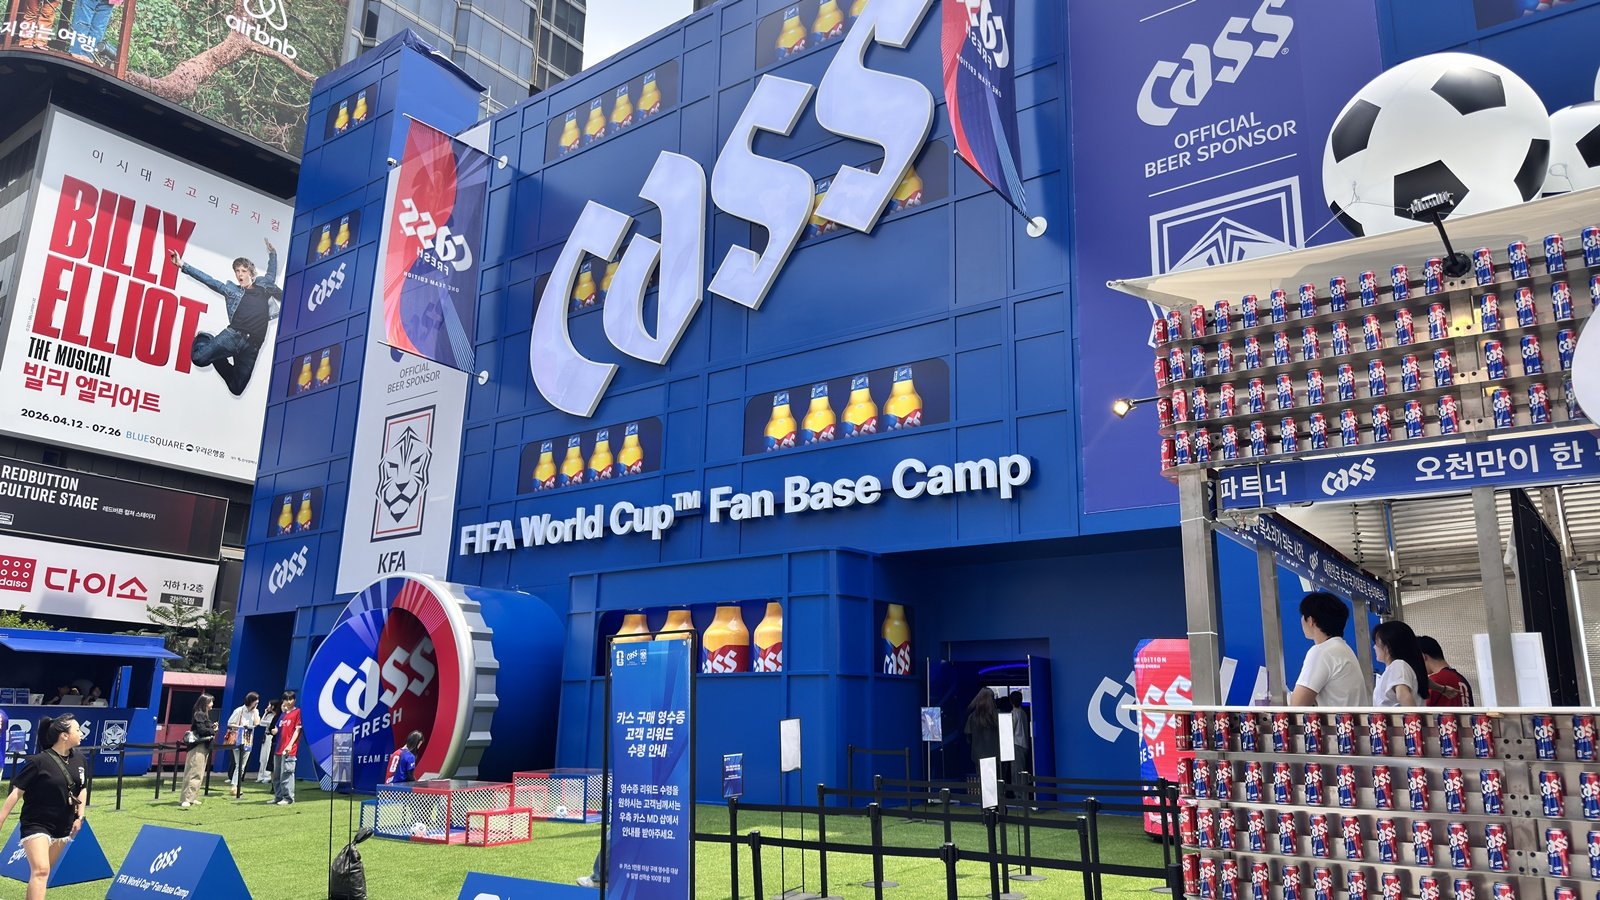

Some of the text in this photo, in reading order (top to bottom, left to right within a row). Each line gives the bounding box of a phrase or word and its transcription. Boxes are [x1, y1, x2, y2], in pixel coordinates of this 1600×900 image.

[0, 20, 99, 52] 지 않는 여행.
[226, 13, 297, 60] airbnb
[1174, 111, 1262, 149] OFFICIAL
[1145, 120, 1298, 178] BEER SPONSOR
[49, 174, 197, 290] BILLY
[31, 253, 208, 375] ELLIOT
[27, 337, 112, 378] THE MUSICAL
[399, 362, 430, 378] OFFICIAL
[23, 361, 161, 413] 빌리 엘리어트
[387, 370, 440, 393] BEER SPONSOR
[21, 408, 83, 429] 2026.04.12
[92, 423, 121, 438] 07.26
[126, 430, 185, 450] BLUESQUARE
[1415, 445, 1539, 481] 오천만이
[1550, 440, 1583, 470] 한
[1, 465, 79, 491] REDBUTTON
[1220, 471, 1287, 499] 파트너
[0, 481, 99, 510] CULTURE STAGE
[459, 519, 516, 555] FIFA
[520, 504, 604, 548] World
[710, 486, 774, 523] Fan
[784, 475, 881, 514] Base
[892, 453, 1031, 499] Camp
[377, 550, 406, 574] KFA
[44, 566, 148, 601] 다이소
[163, 580, 180, 590] 지하
[352, 708, 403, 742] FRESH
[616, 710, 685, 725] 카스 구매 영수증
[625, 727, 673, 741] 고객 리워드
[358, 754, 380, 764] TEAM
[628, 744, 667, 758] 수령 안내
[620, 784, 679, 796] 영수증 리워드 수령을
[618, 798, 681, 811] 원하시는 고객님께서는
[619, 812, 678, 826] 우측 카스 MD 샵에서
[622, 827, 640, 838] 안내를
[116, 874, 129, 884] FIFA
[127, 876, 142, 887] World
[152, 882, 163, 891] Fan
[161, 884, 175, 895] Base
[173, 886, 189, 899] Camp
